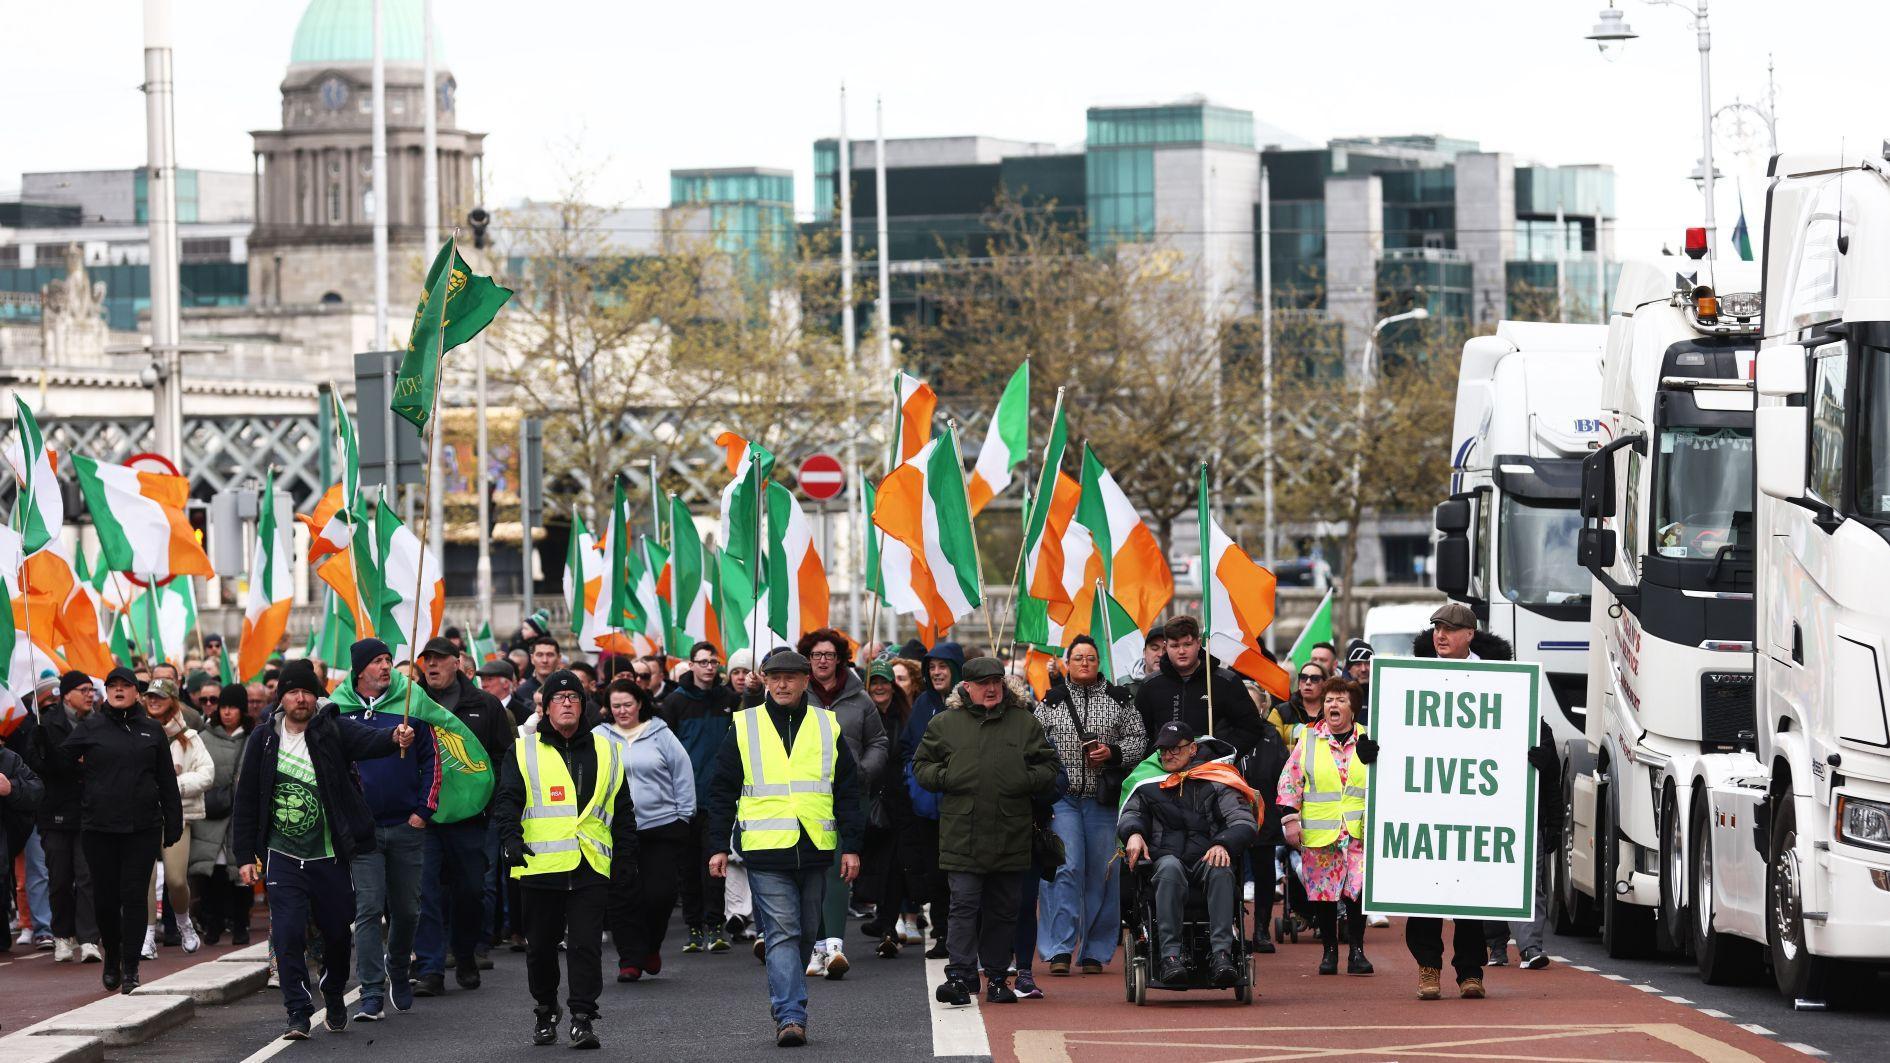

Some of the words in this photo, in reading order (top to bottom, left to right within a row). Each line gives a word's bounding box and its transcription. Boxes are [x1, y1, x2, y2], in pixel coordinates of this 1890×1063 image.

[1710, 674, 1754, 683] VOLV
[1404, 689, 1502, 730] IRISH
[1404, 755, 1499, 797] LIVES
[1382, 821, 1516, 864] MATTER
